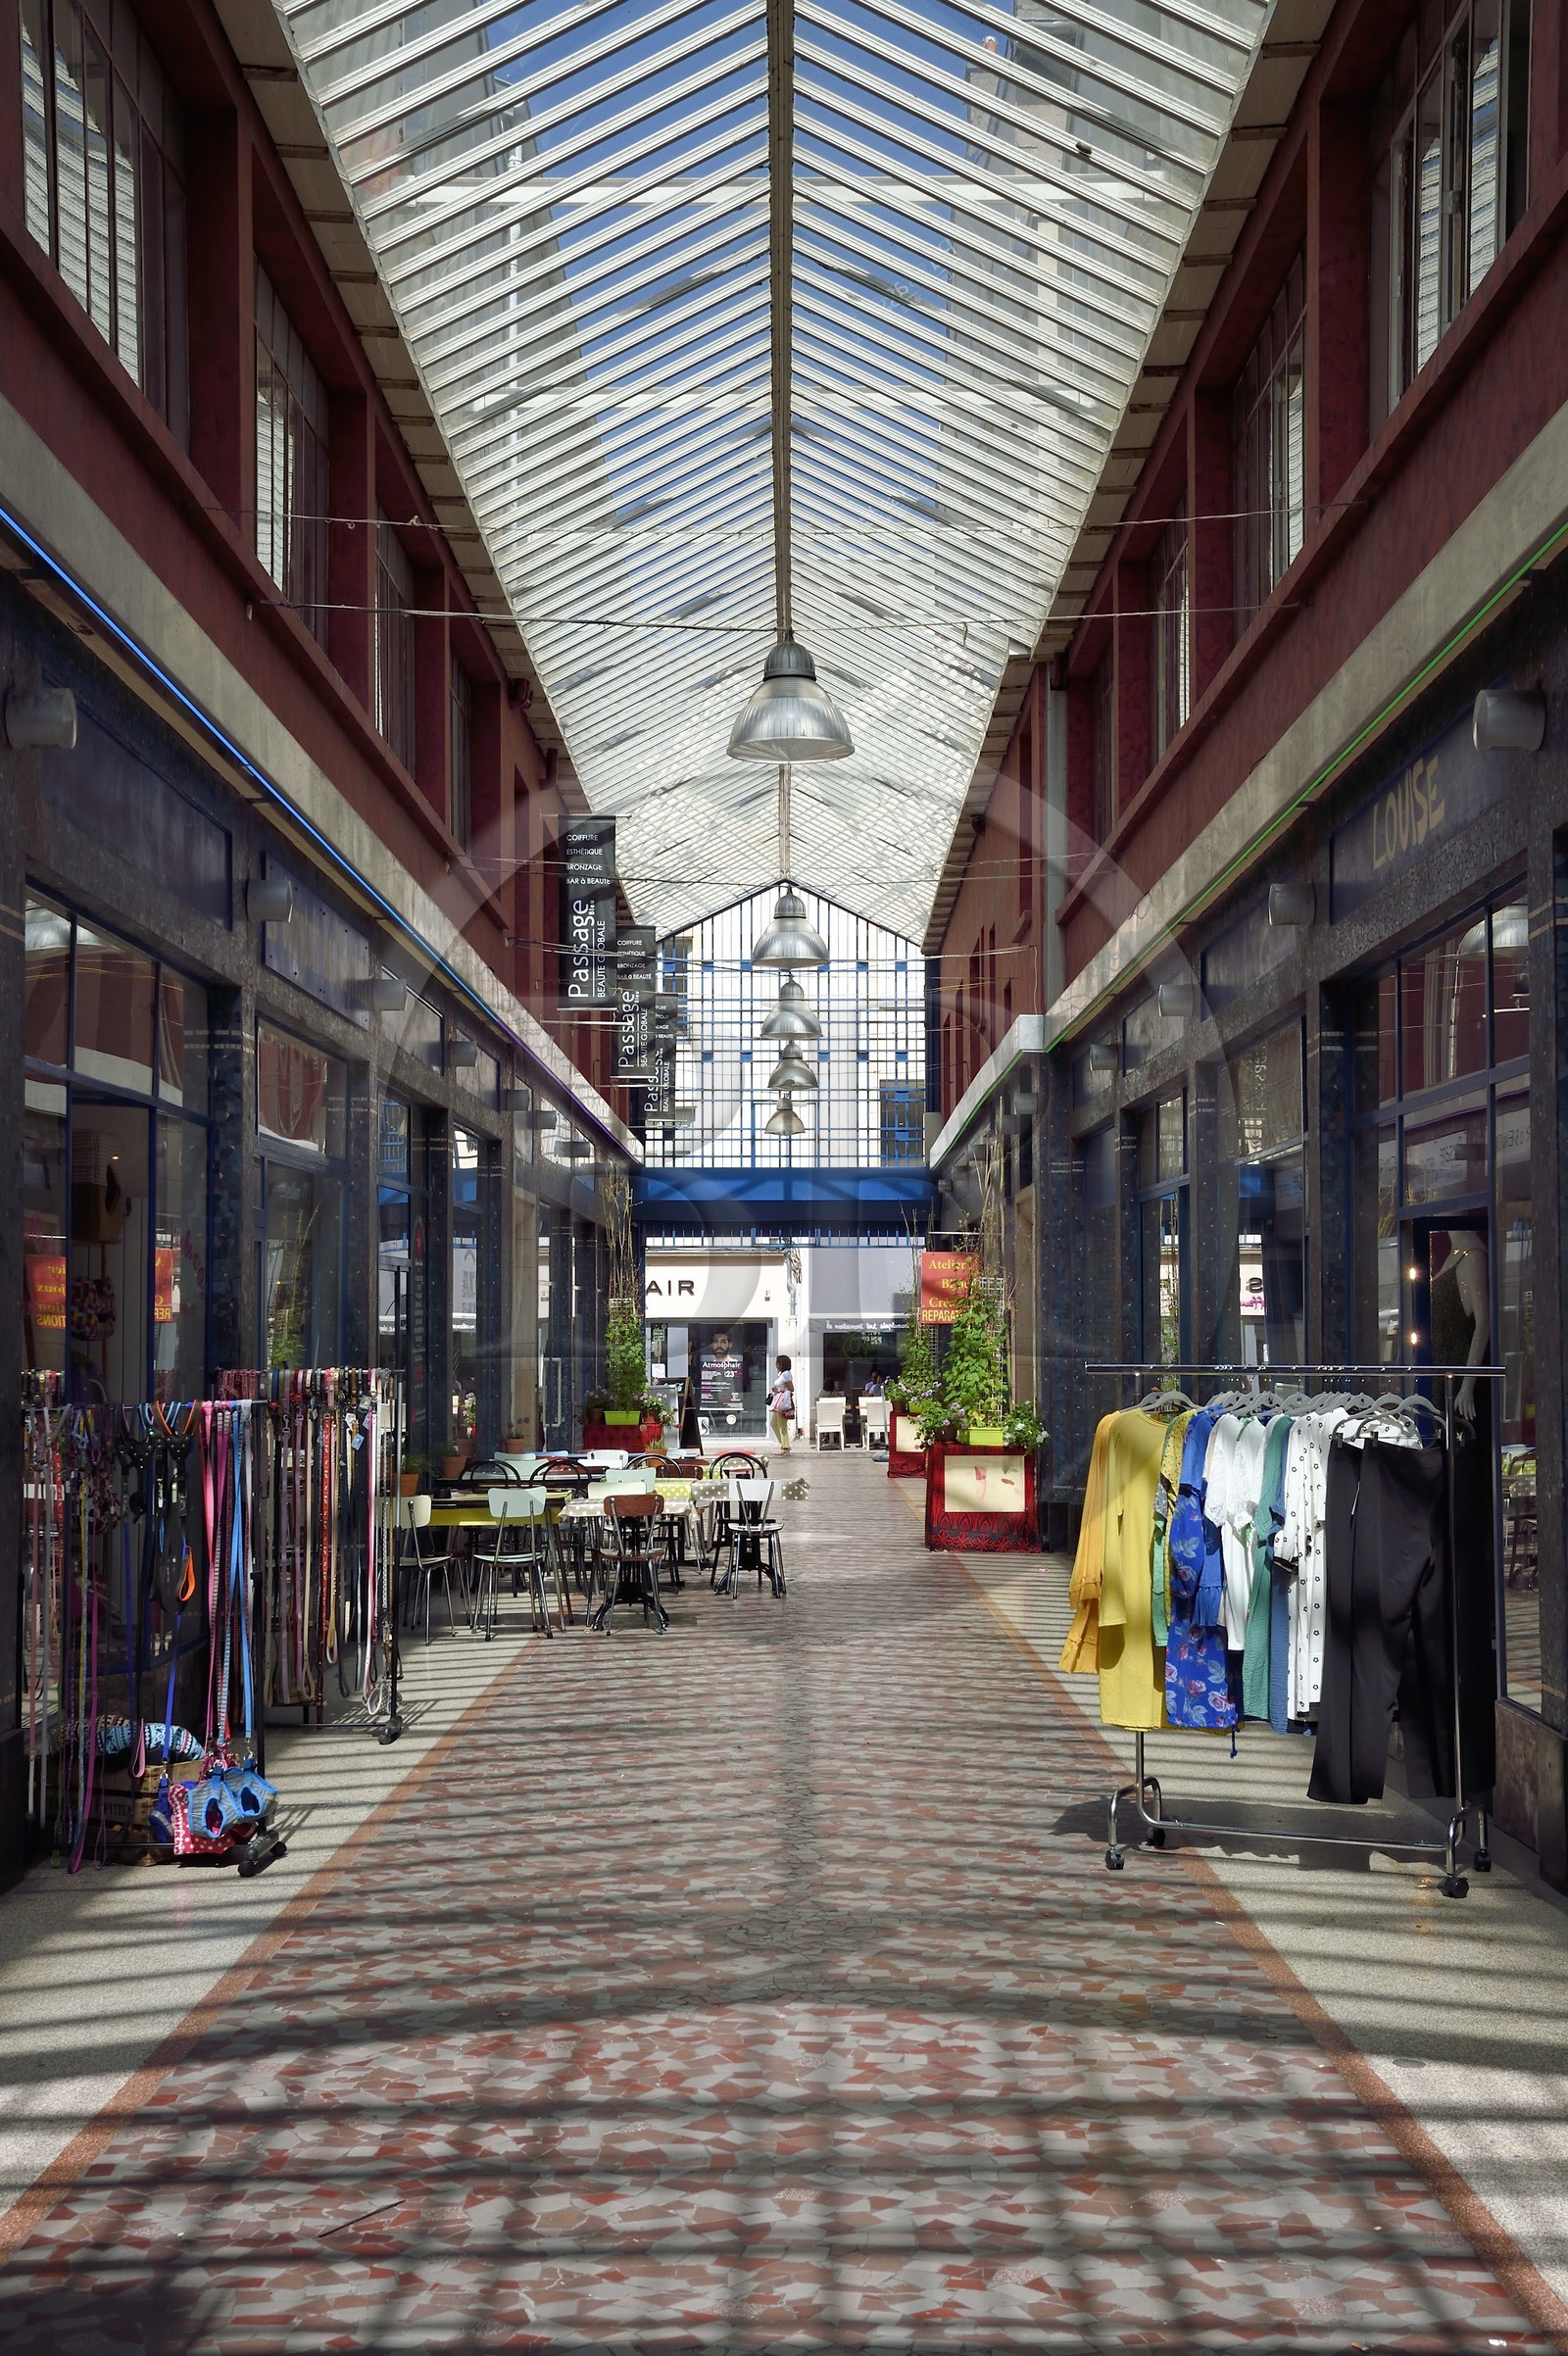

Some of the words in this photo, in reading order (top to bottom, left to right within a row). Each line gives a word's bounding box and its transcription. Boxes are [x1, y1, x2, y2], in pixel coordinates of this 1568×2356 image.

[1373, 755, 1446, 871] LOUISE
[566, 847, 603, 856] ESTHÉTIQUE
[568, 900, 595, 998] Passage
[618, 991, 639, 1067] Passage
[929, 1258, 966, 1270] Atelier
[645, 1280, 695, 1296] AIR
